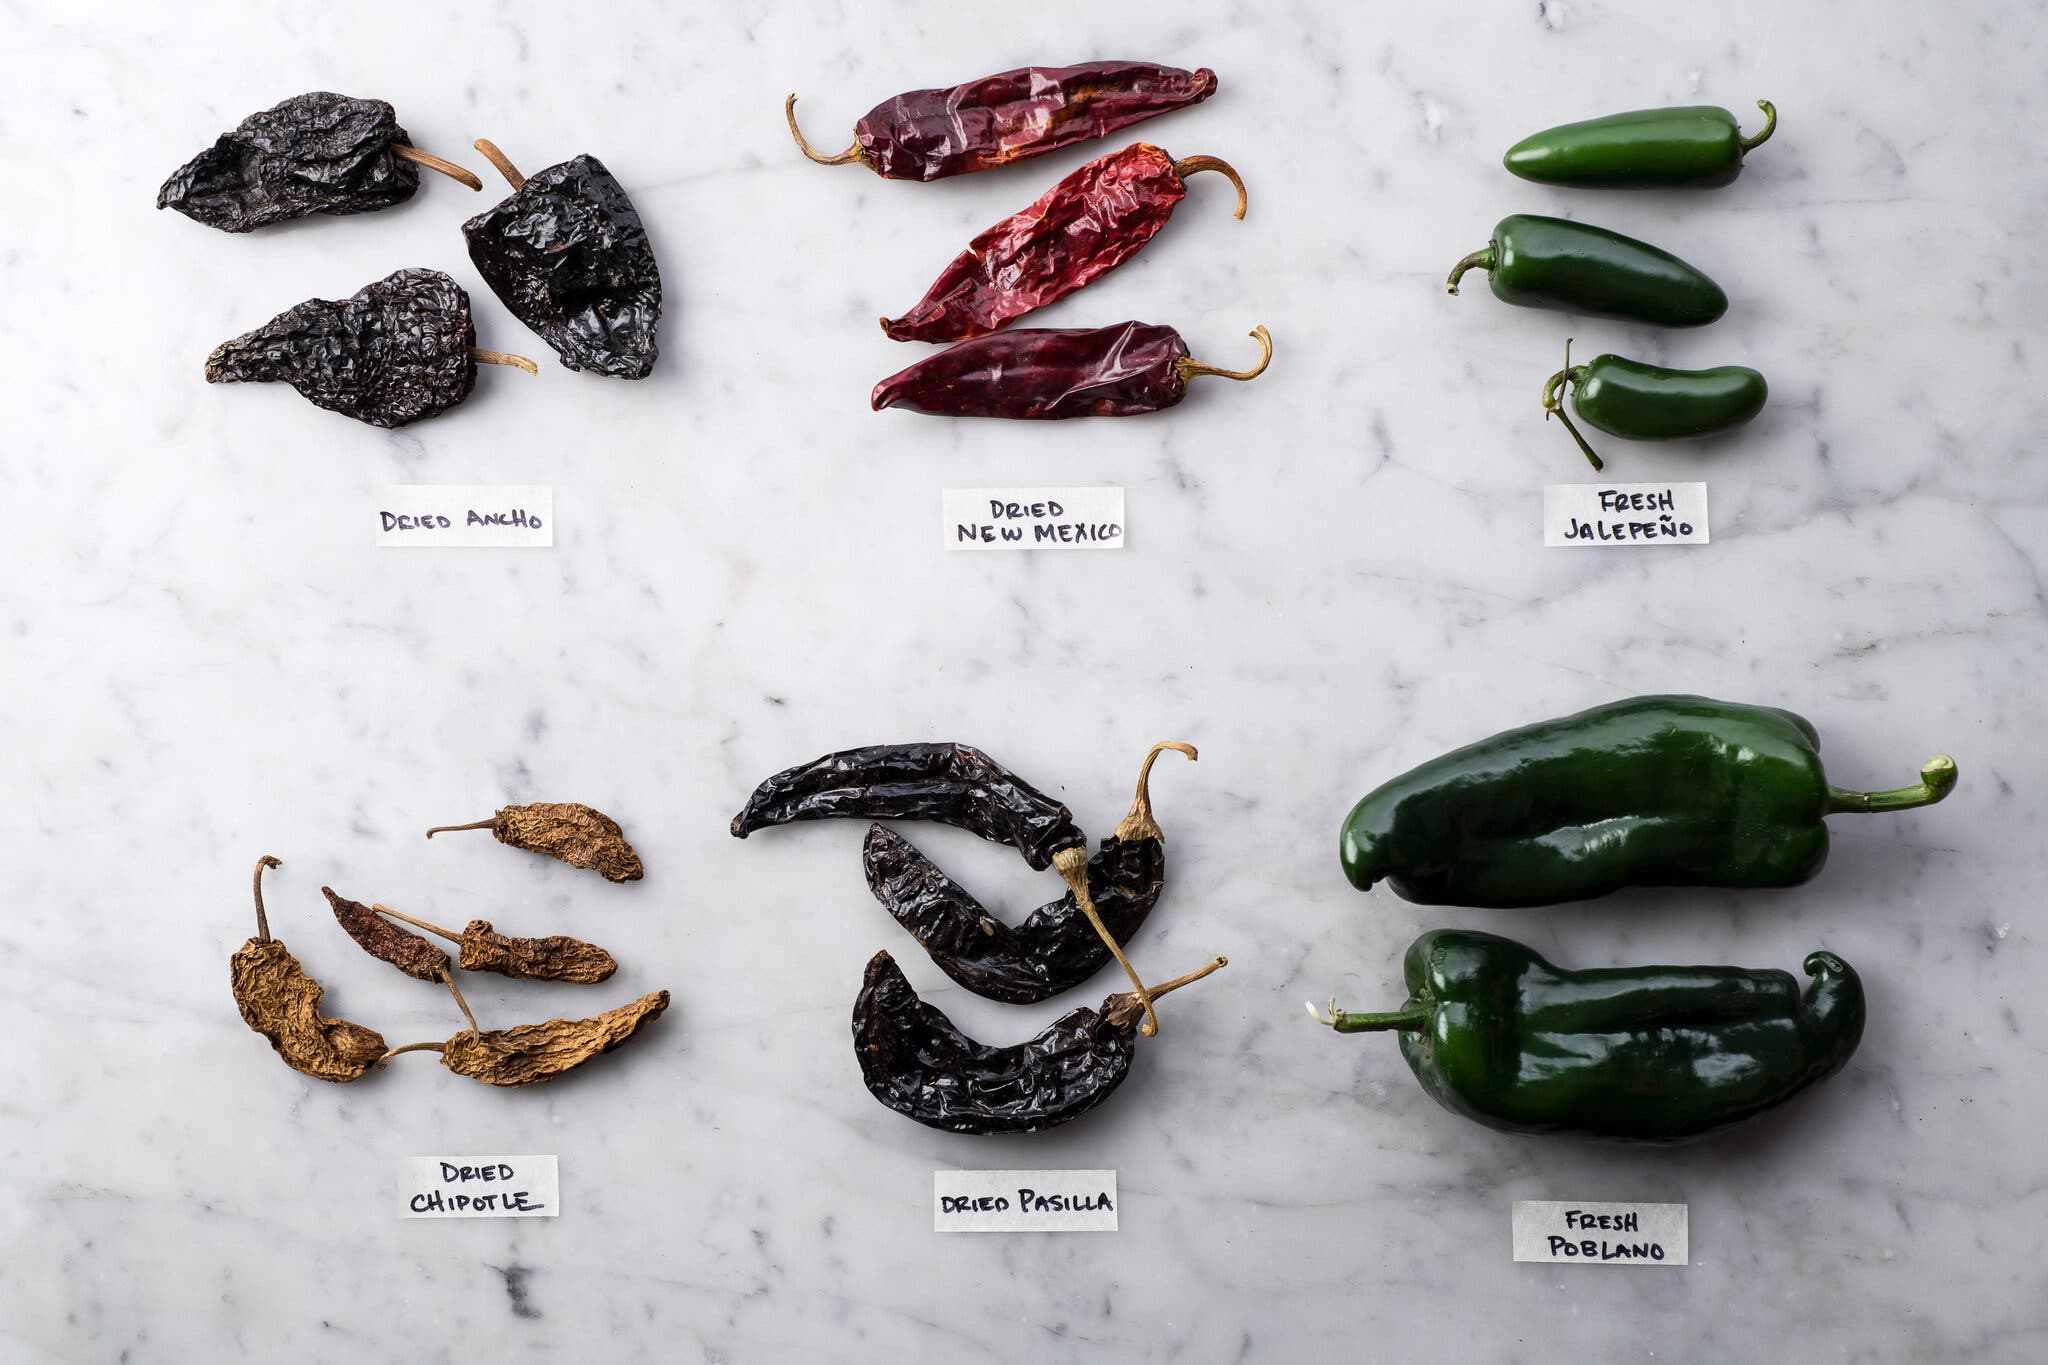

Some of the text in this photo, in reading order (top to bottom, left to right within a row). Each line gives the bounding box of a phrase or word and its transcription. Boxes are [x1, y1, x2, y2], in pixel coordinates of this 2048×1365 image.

[989, 499, 1064, 519] DRIED
[1598, 489, 1675, 514] FRESH
[380, 509, 542, 532] DRIED ANCHO
[1564, 514, 1693, 541] JALEPEÑO
[957, 523, 1122, 544] NEW MEXICO
[440, 1161, 514, 1183] DRIED
[410, 1189, 545, 1213] CHIPOTLE
[940, 1188, 1114, 1214] DRIED PASILLA
[1564, 1209, 1639, 1233] FRESH
[1546, 1235, 1666, 1261] POBLANO
